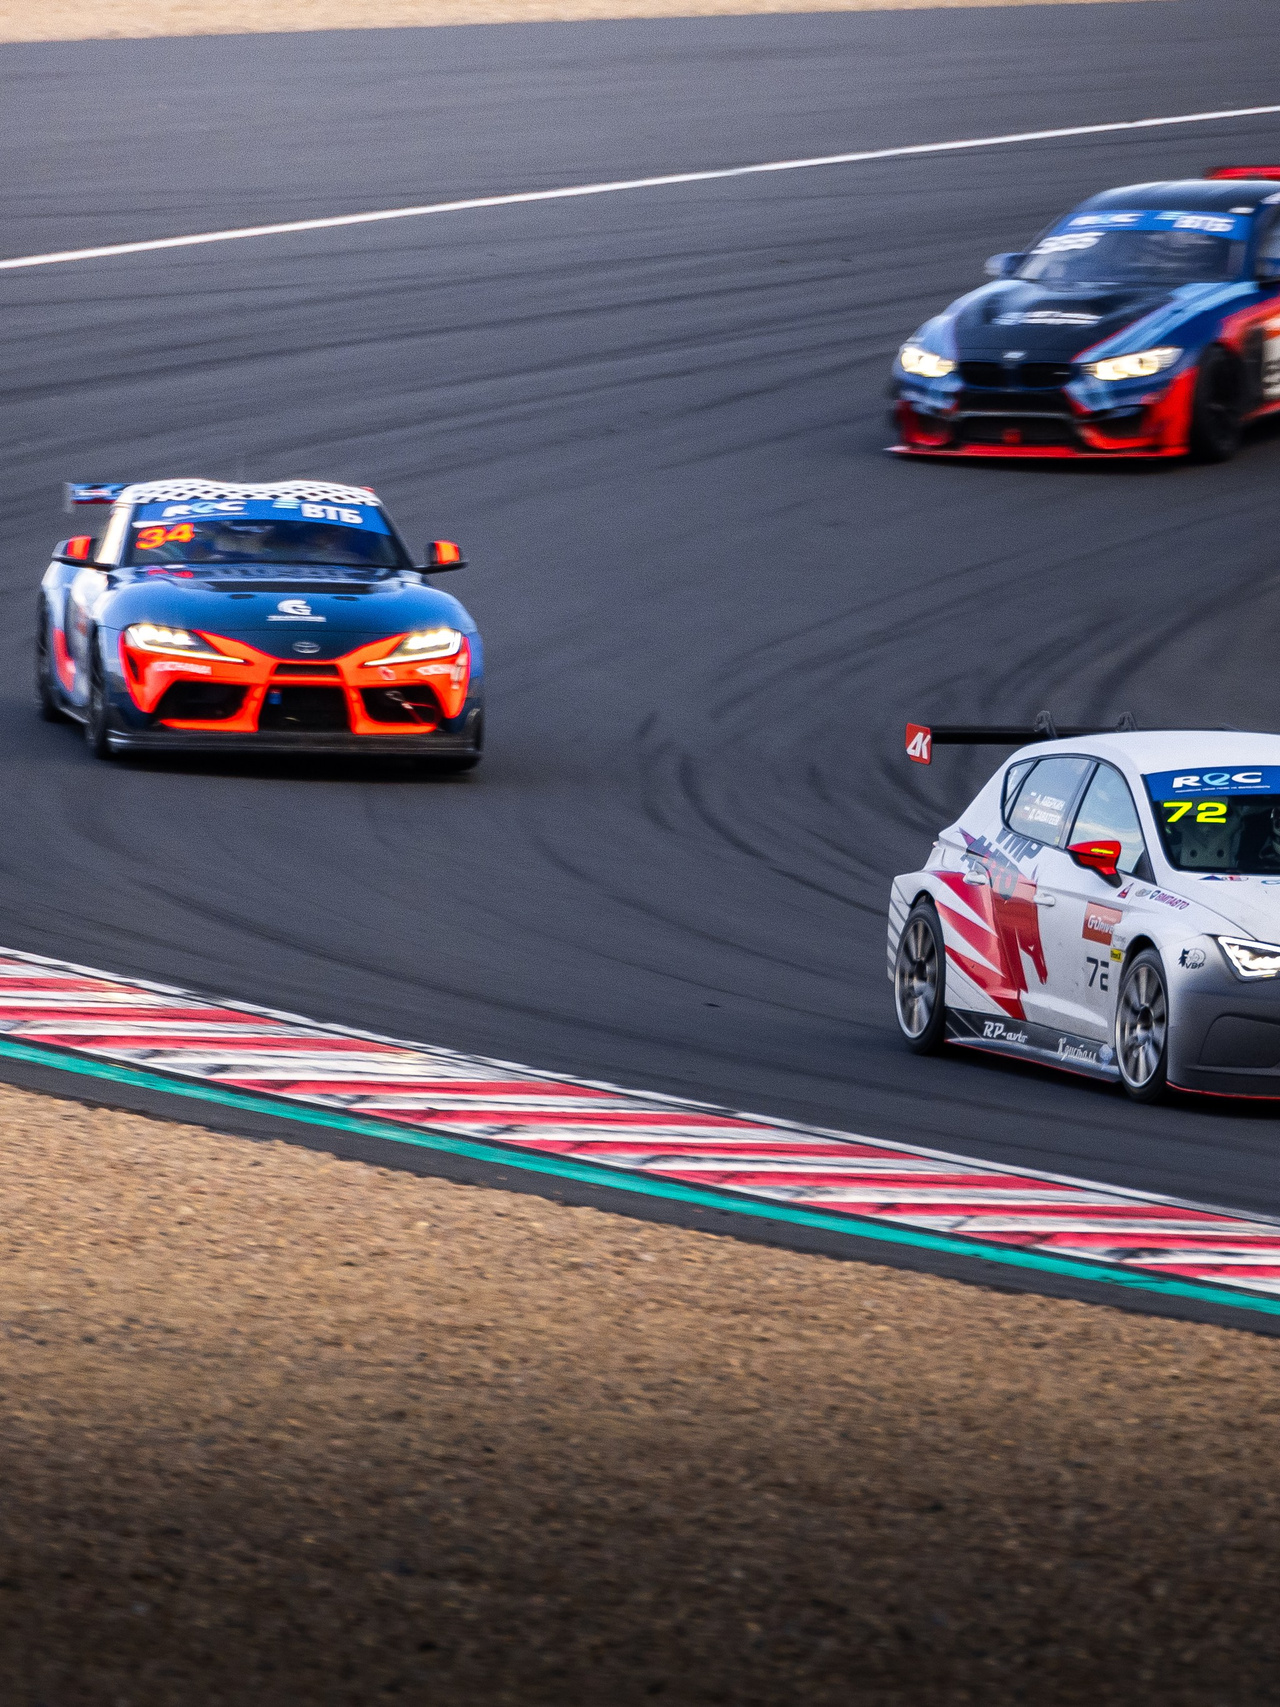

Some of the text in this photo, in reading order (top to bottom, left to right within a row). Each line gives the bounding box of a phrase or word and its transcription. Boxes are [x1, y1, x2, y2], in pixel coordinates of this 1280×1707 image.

[302, 503, 363, 524] ВТБ
[136, 522, 194, 549] 34
[1163, 802, 1227, 824] 72
[995, 828, 1044, 863] VMP
